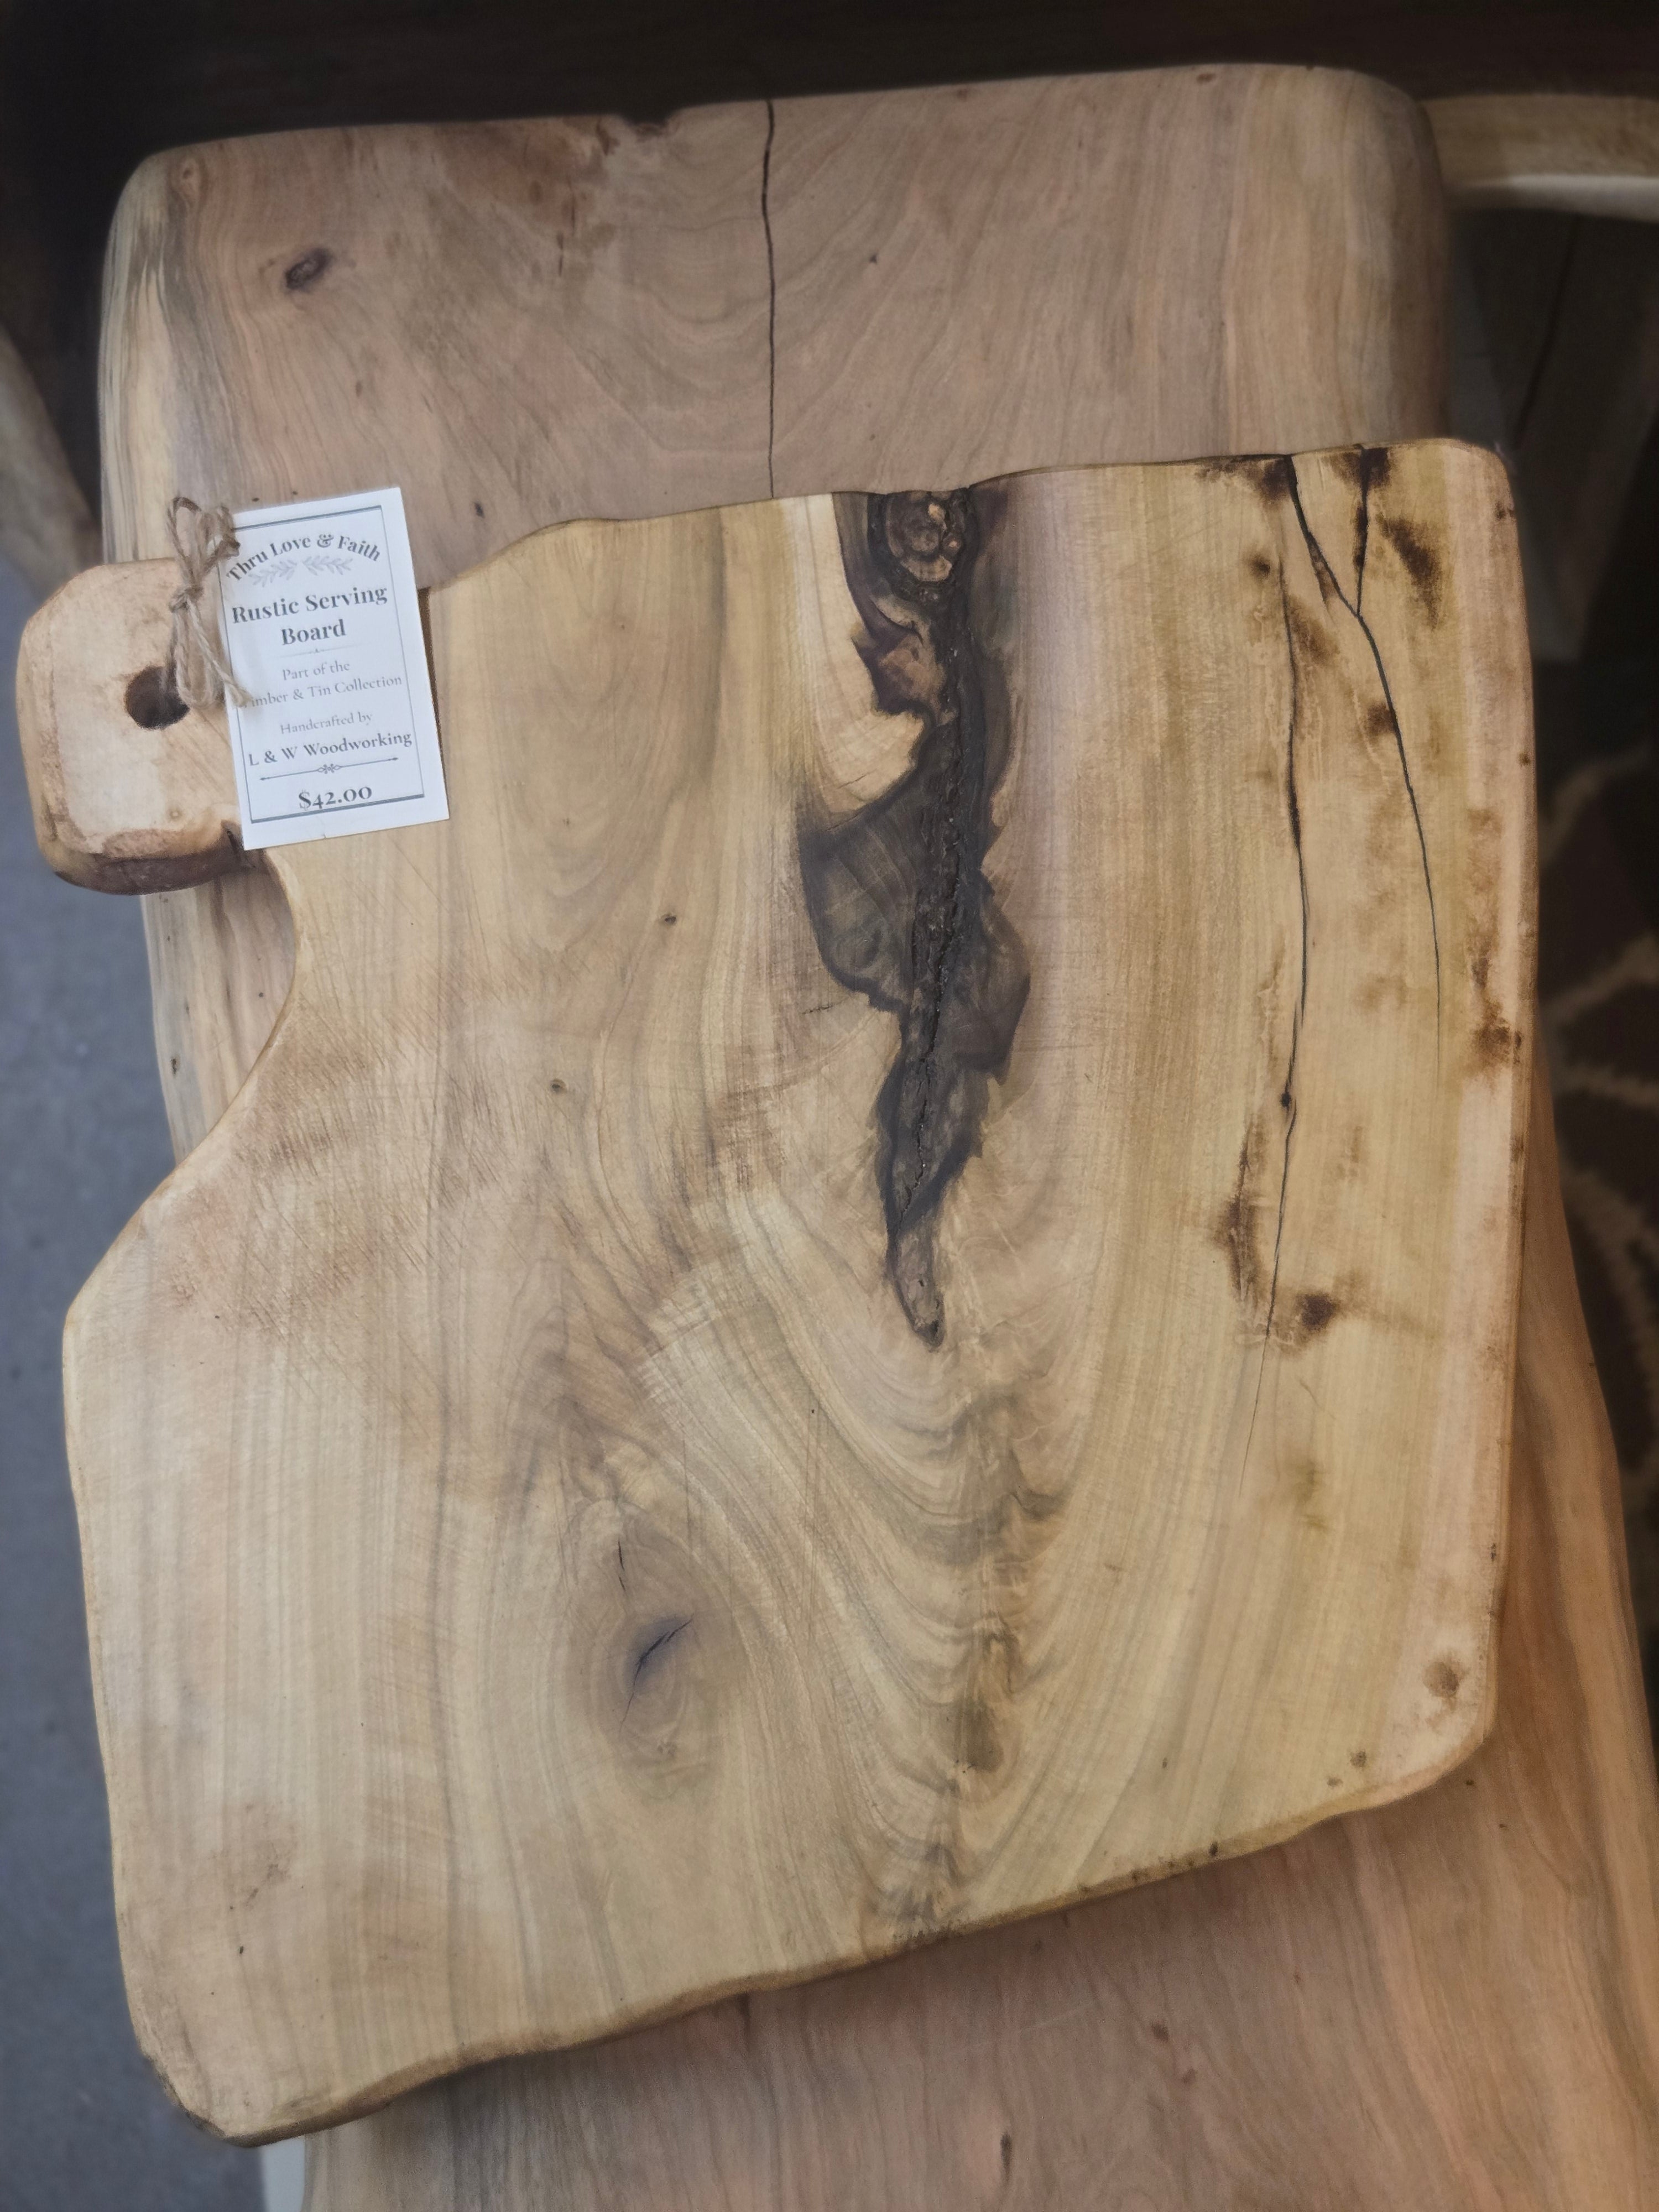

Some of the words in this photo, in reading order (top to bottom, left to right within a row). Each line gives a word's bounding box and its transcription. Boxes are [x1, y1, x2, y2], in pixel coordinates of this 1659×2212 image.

[226, 550, 269, 581] Thru
[270, 536, 311, 556] Love
[317, 534, 334, 548] &
[337, 535, 381, 561] Faith
[232, 598, 299, 624] Rustic
[305, 587, 387, 612] Serving
[280, 619, 347, 645] Board
[283, 668, 309, 680] Part
[313, 662, 328, 676] of
[330, 660, 350, 673] the
[244, 692, 288, 708] imber
[293, 688, 304, 700] &
[307, 685, 331, 698] Tin
[335, 676, 403, 693] Collection
[280, 713, 354, 734] Handcrafted
[357, 711, 373, 726] by
[249, 754, 260, 766] L
[264, 750, 278, 764] &
[281, 747, 298, 760] W
[304, 733, 413, 757] Woodworking
[298, 786, 373, 811] $42.00
